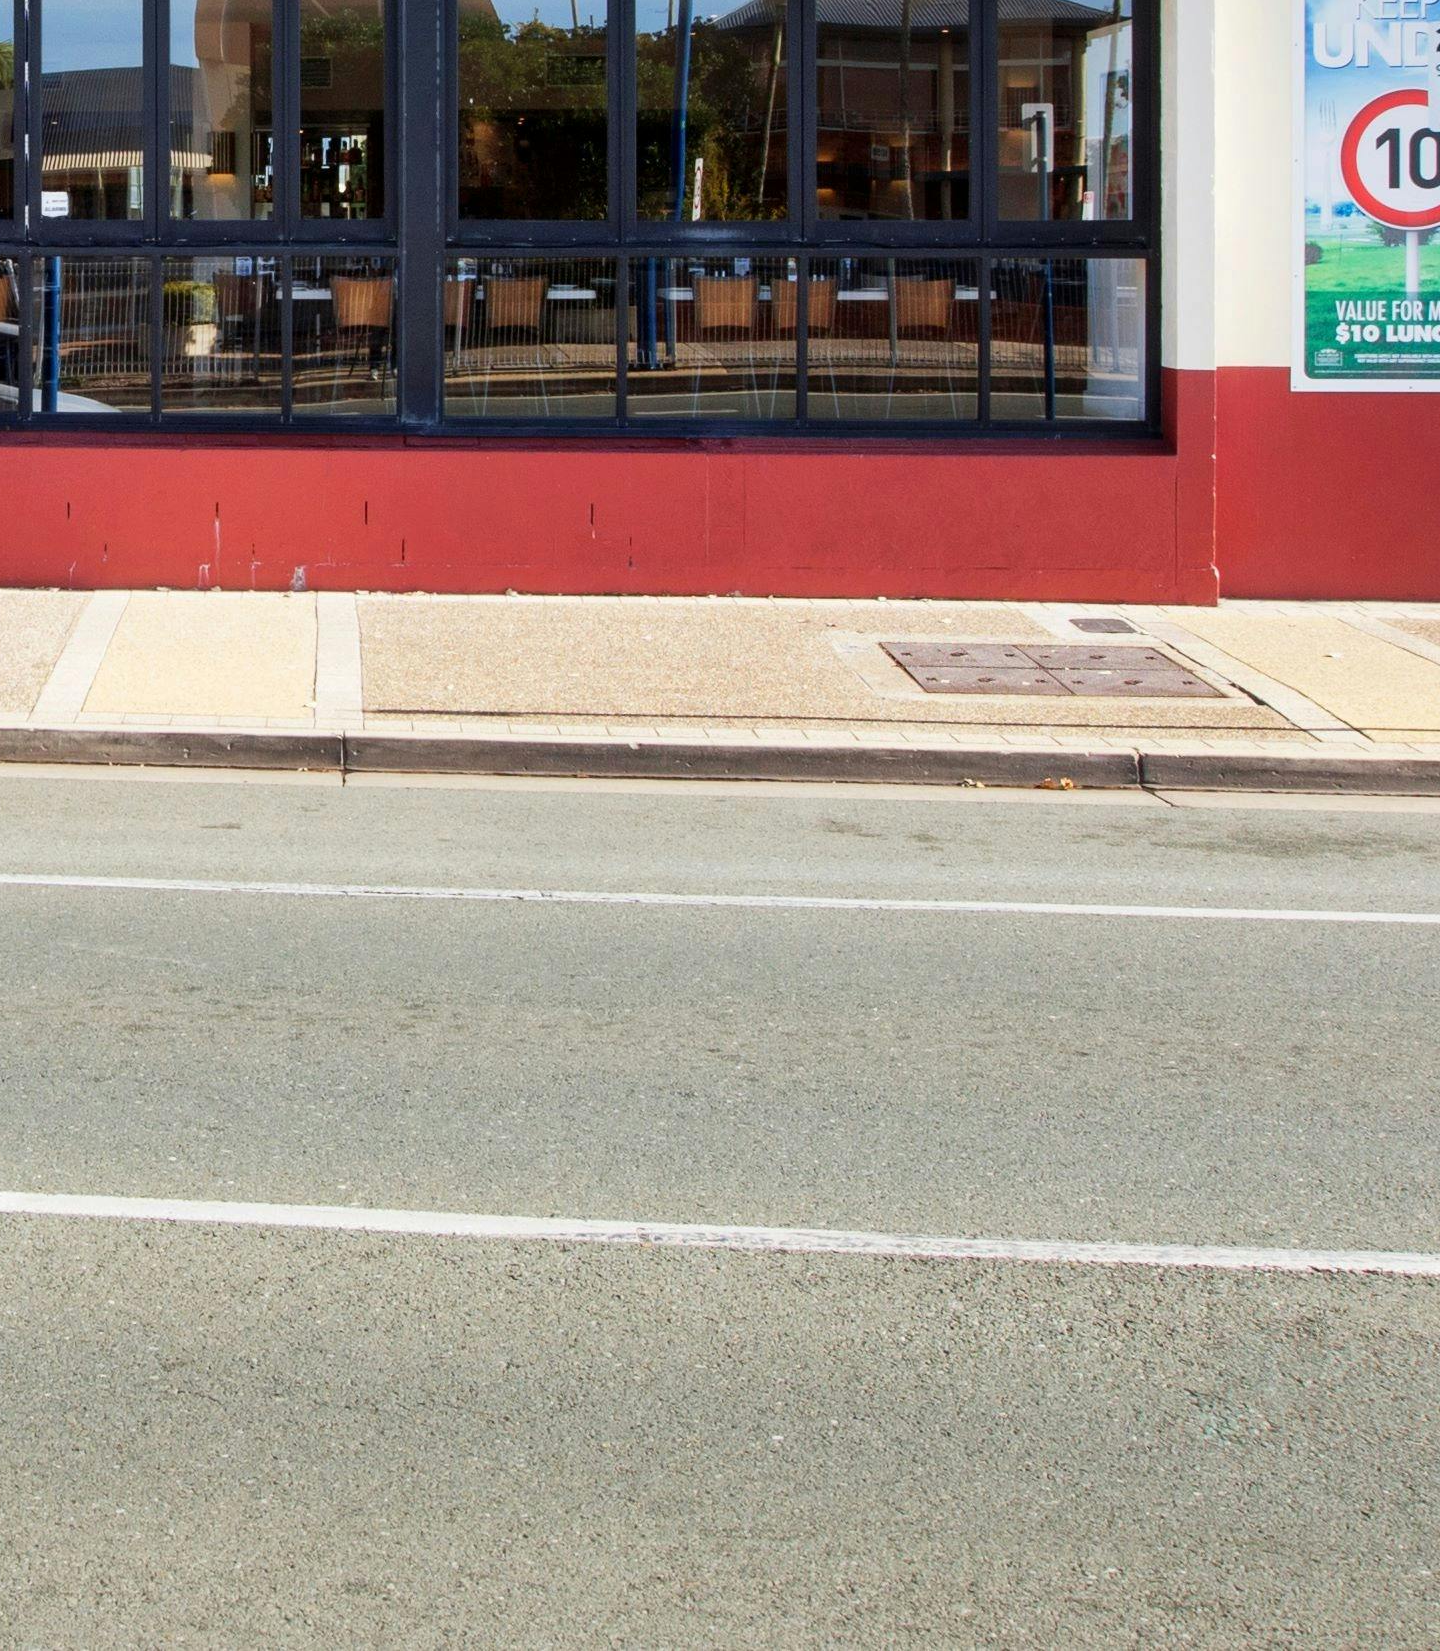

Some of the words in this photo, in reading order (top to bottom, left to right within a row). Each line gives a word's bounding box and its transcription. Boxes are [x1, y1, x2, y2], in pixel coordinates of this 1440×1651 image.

[1335, 300, 1386, 321] VALUE
[1392, 300, 1423, 321] FOR
[1335, 322, 1380, 345] $10
